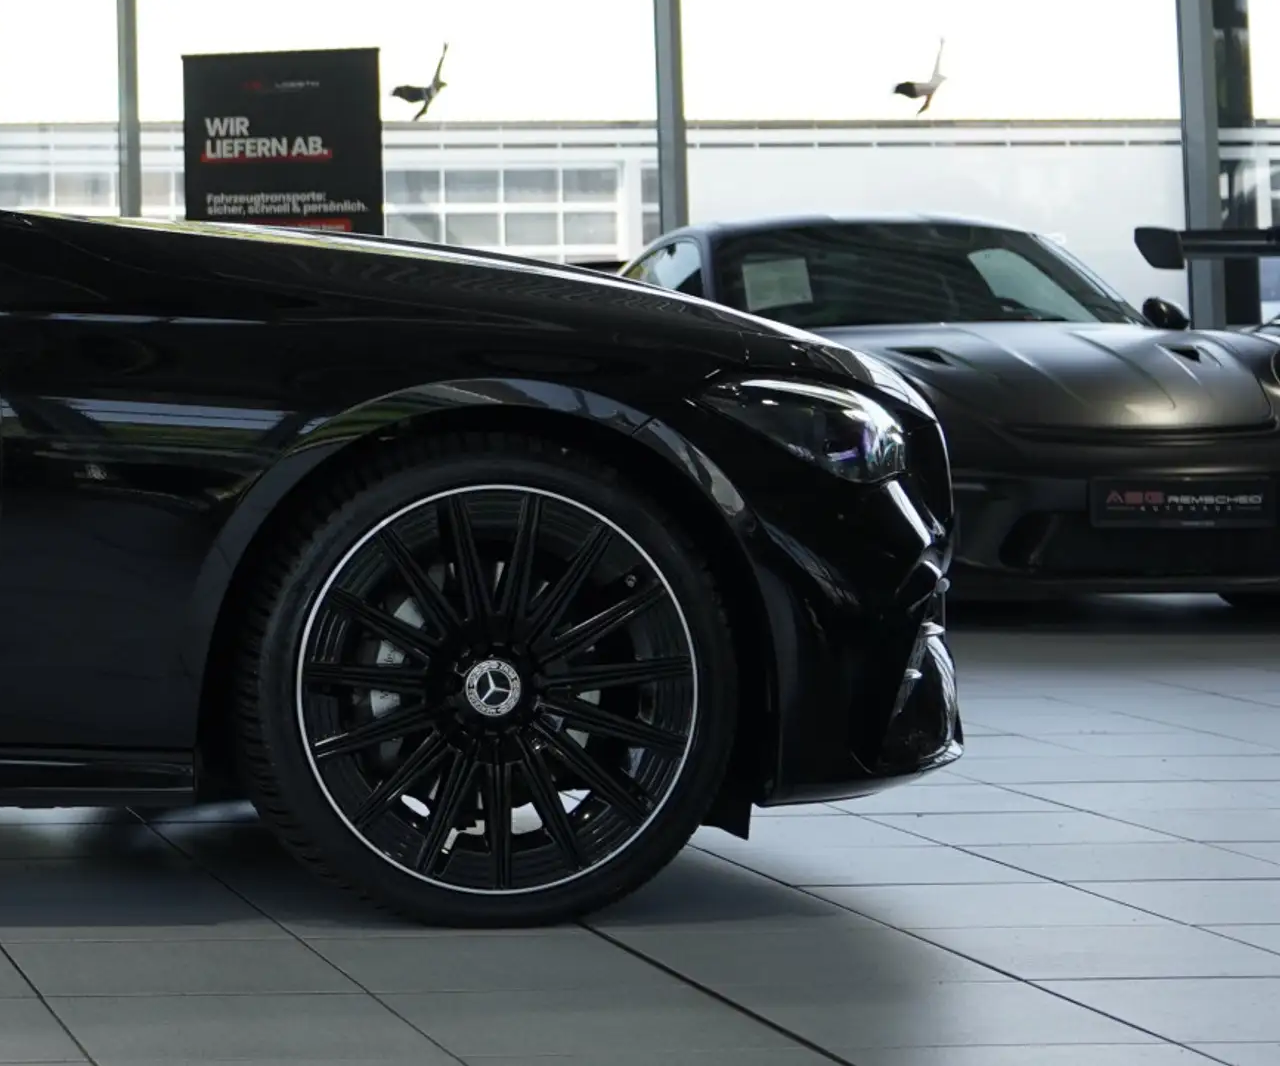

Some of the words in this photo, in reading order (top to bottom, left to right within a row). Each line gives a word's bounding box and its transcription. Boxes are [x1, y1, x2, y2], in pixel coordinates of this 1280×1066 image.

[205, 116, 250, 136] WIR
[205, 137, 288, 159] LIEFERN
[291, 136, 328, 158] AB.
[207, 202, 246, 217] sicher,
[247, 201, 291, 215] schnell
